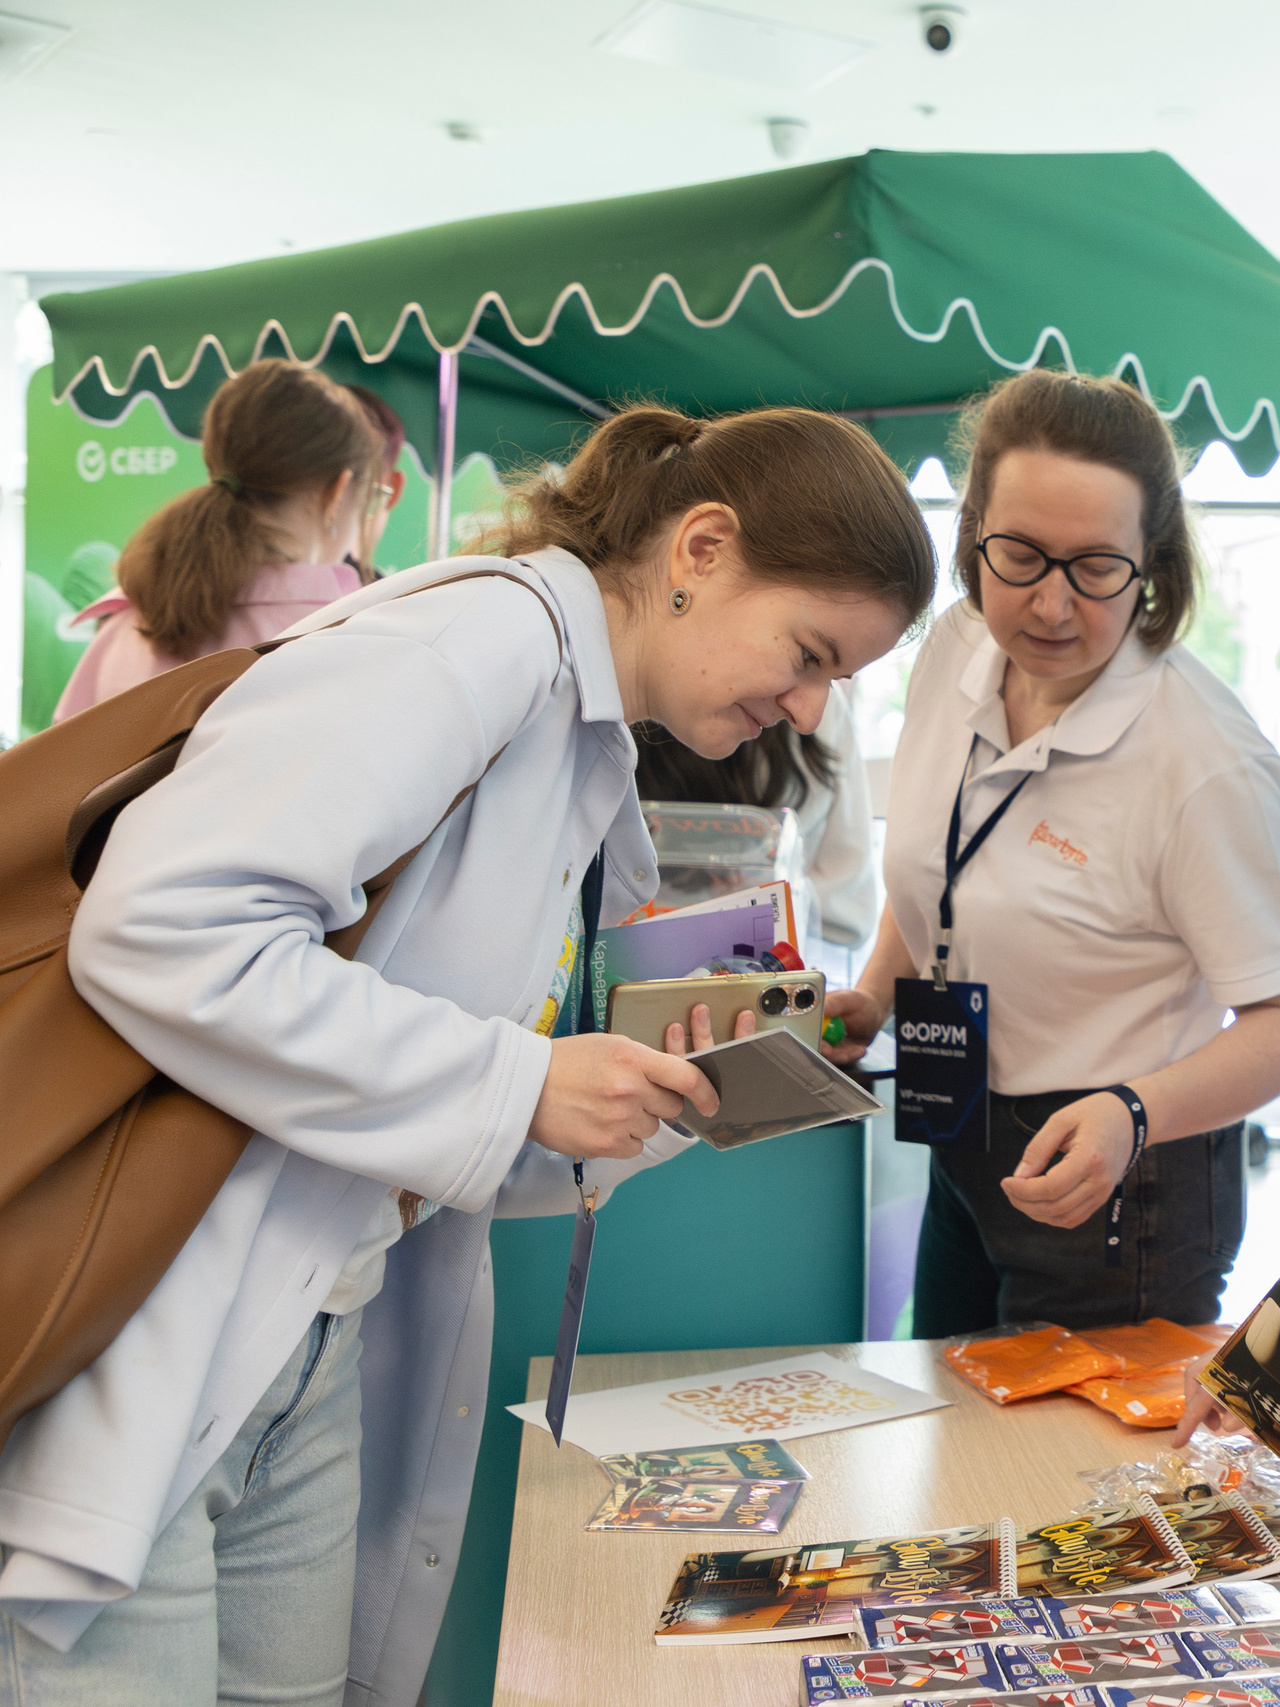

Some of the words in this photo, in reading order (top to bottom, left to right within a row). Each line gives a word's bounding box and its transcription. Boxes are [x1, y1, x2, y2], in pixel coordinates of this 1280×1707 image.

[110, 446, 177, 475] СБЕР
[591, 940, 607, 1008] Карьера
[900, 1020, 968, 1046] ФОРУМ
[880, 1537, 948, 1604] GlowByte
[1039, 1520, 1118, 1586] GlowByte
